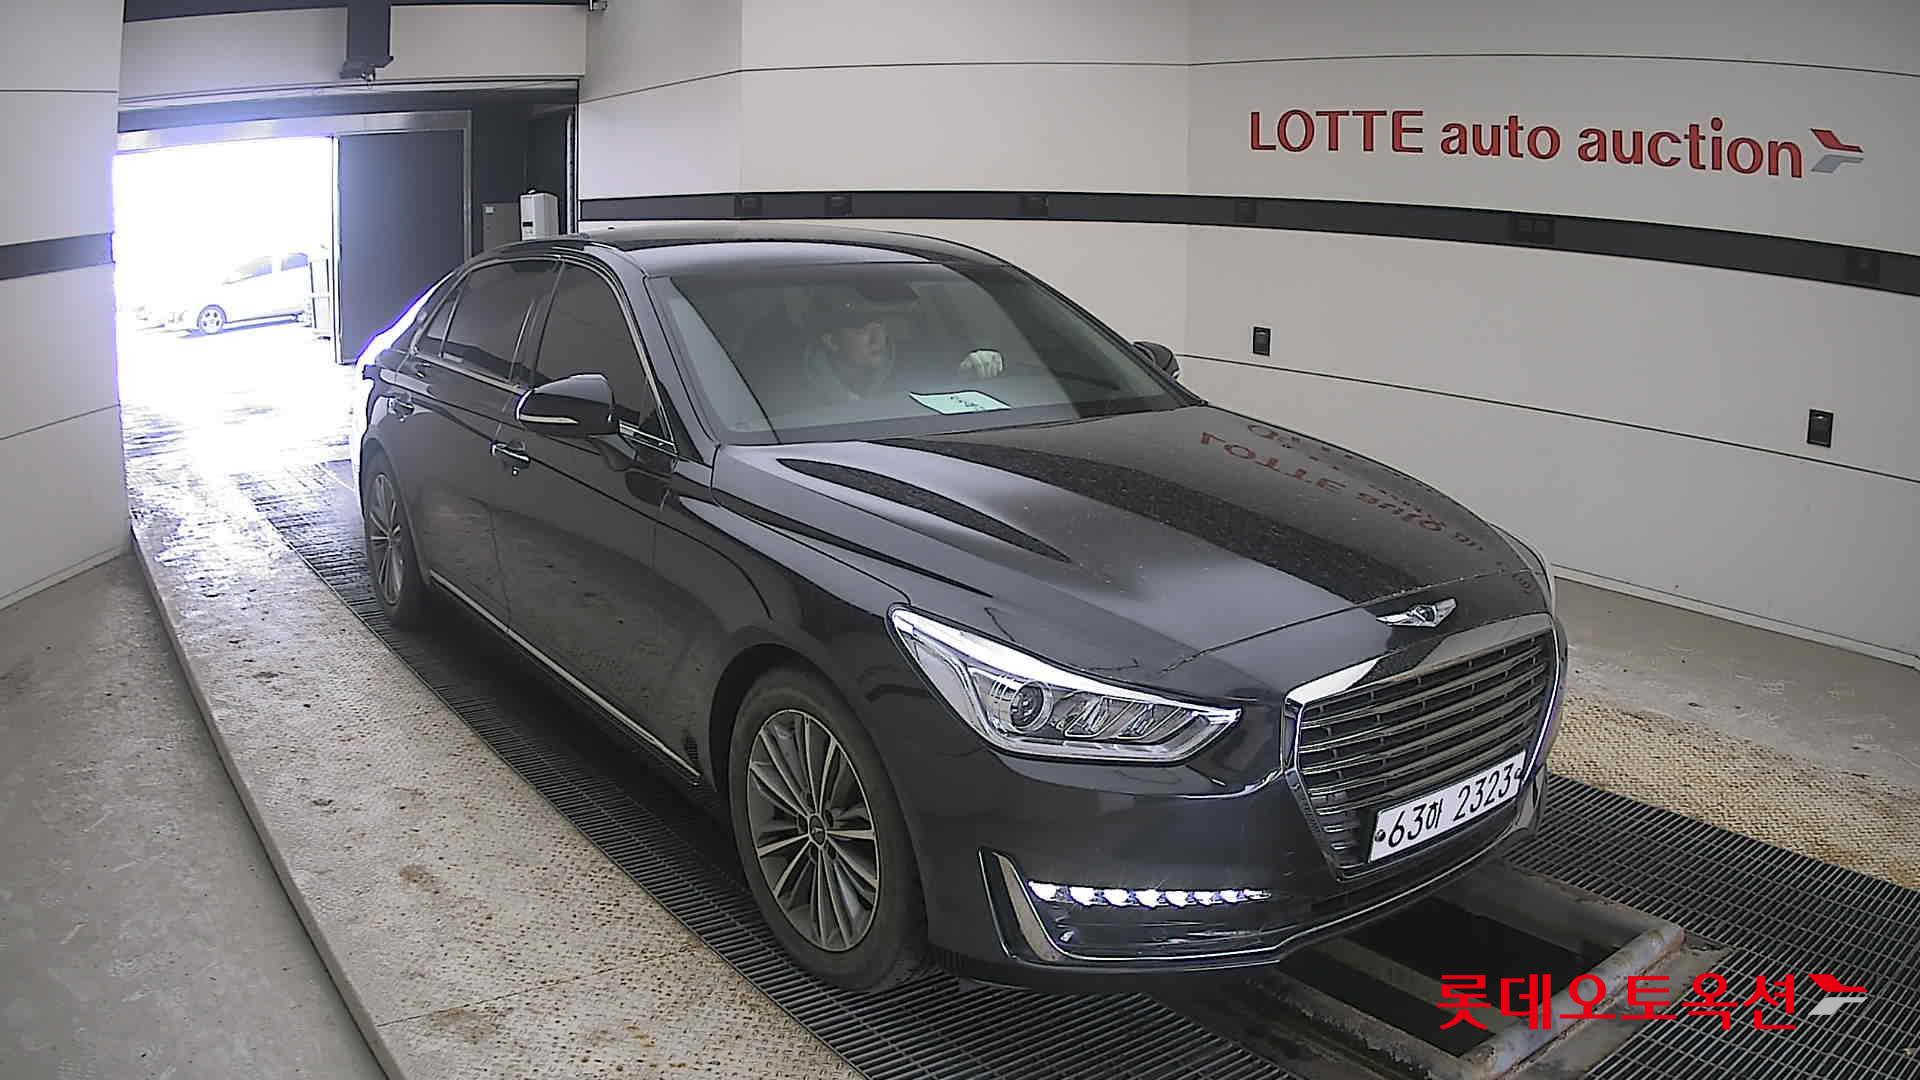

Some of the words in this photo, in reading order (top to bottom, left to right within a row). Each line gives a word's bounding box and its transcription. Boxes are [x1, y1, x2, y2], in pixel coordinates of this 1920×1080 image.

[1250, 110, 1424, 153] LOTTE
[1441, 115, 1561, 158] auto
[1578, 117, 1803, 178] auction
[1388, 798, 1443, 848] 63하
[1453, 763, 1515, 822] 2323
